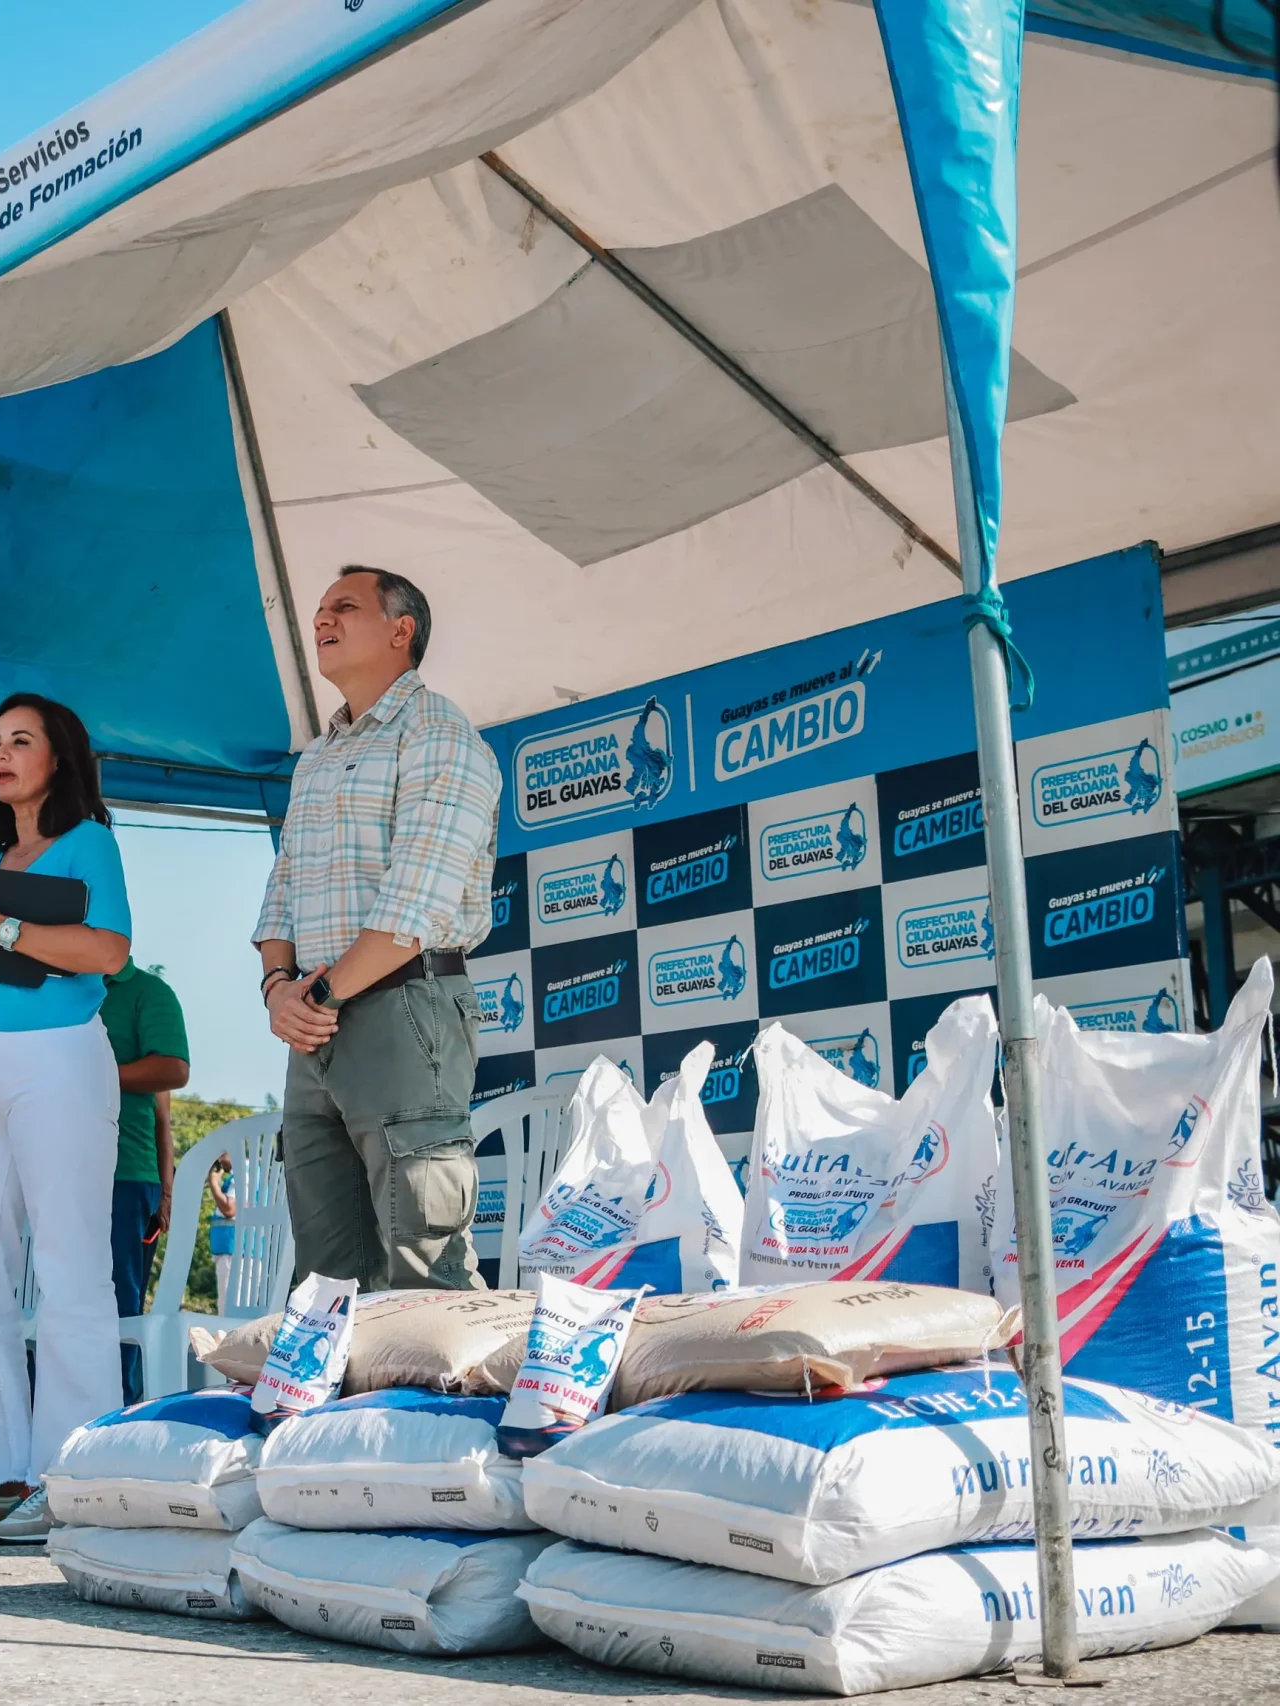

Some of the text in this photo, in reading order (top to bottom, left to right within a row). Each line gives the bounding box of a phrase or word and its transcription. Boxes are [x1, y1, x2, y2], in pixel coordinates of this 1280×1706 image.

[0, 126, 142, 230] de Formación
[720, 660, 853, 725] Guayas se mueve al
[721, 688, 859, 774] CAMBIO
[1180, 717, 1228, 744] COSMO
[525, 733, 619, 773] PREFECTURA
[525, 753, 620, 792] CIUDADANA
[1041, 762, 1119, 789] PREFECTURA
[526, 772, 621, 812] DEL GUAYAS
[1042, 777, 1120, 802] CIUDADANA
[898, 801, 930, 821] Guayas
[931, 799, 942, 811] se
[943, 791, 974, 808] mueve
[1042, 790, 1121, 816] DEL GUAYAS
[767, 824, 831, 846] PREFECTURA
[898, 804, 985, 850] CAMBIO
[650, 841, 722, 873] Guayas se mueve al
[768, 837, 833, 859] CIUDADANA
[769, 848, 834, 871] DEL GUAYAS
[543, 873, 597, 892] PREFECTURA
[543, 883, 598, 903] CIUDADANA
[650, 862, 725, 900] CAMBIO
[1049, 873, 1145, 909] Guayas se mueve al
[544, 895, 598, 915] DEL GUAYAS
[1049, 893, 1150, 942] CAMBIO
[905, 910, 975, 931] PREFECTURA
[906, 923, 977, 944] CIUDADANA
[773, 924, 852, 955] Guayas se mueve al
[907, 936, 978, 957] DEL GUAYAS
[655, 954, 714, 972] PREFECTURA
[656, 966, 715, 984] CIUDADANA
[773, 942, 856, 985] CAMBIO
[547, 964, 613, 993] Guayas se mueve al
[656, 978, 716, 997] DEL GUAYAS
[547, 981, 616, 1018] CAMBIO
[484, 1086, 505, 1099] mueve
[505, 1082, 513, 1093] al
[1067, 1197, 1117, 1213] GRATUITO
[823, 1245, 849, 1255] VENTA
[549, 1265, 576, 1275] VENTA
[1055, 1258, 1085, 1269] VENTA
[446, 1299, 498, 1313] 30
[535, 1307, 577, 1329] ODUCTO
[528, 1350, 571, 1366] GUAYAS
[1186, 1311, 1219, 1409] 12-15
[269, 1377, 315, 1404] SU VENTA
[543, 1383, 559, 1395] SU
[562, 1386, 599, 1413] VENTA
[867, 1391, 976, 1419] LECHE
[951, 1449, 1119, 1496] nutran
[730, 1534, 772, 1552] sacoplast
[981, 1580, 1136, 1622] nutvan
[758, 1654, 804, 1669] sacoplast
